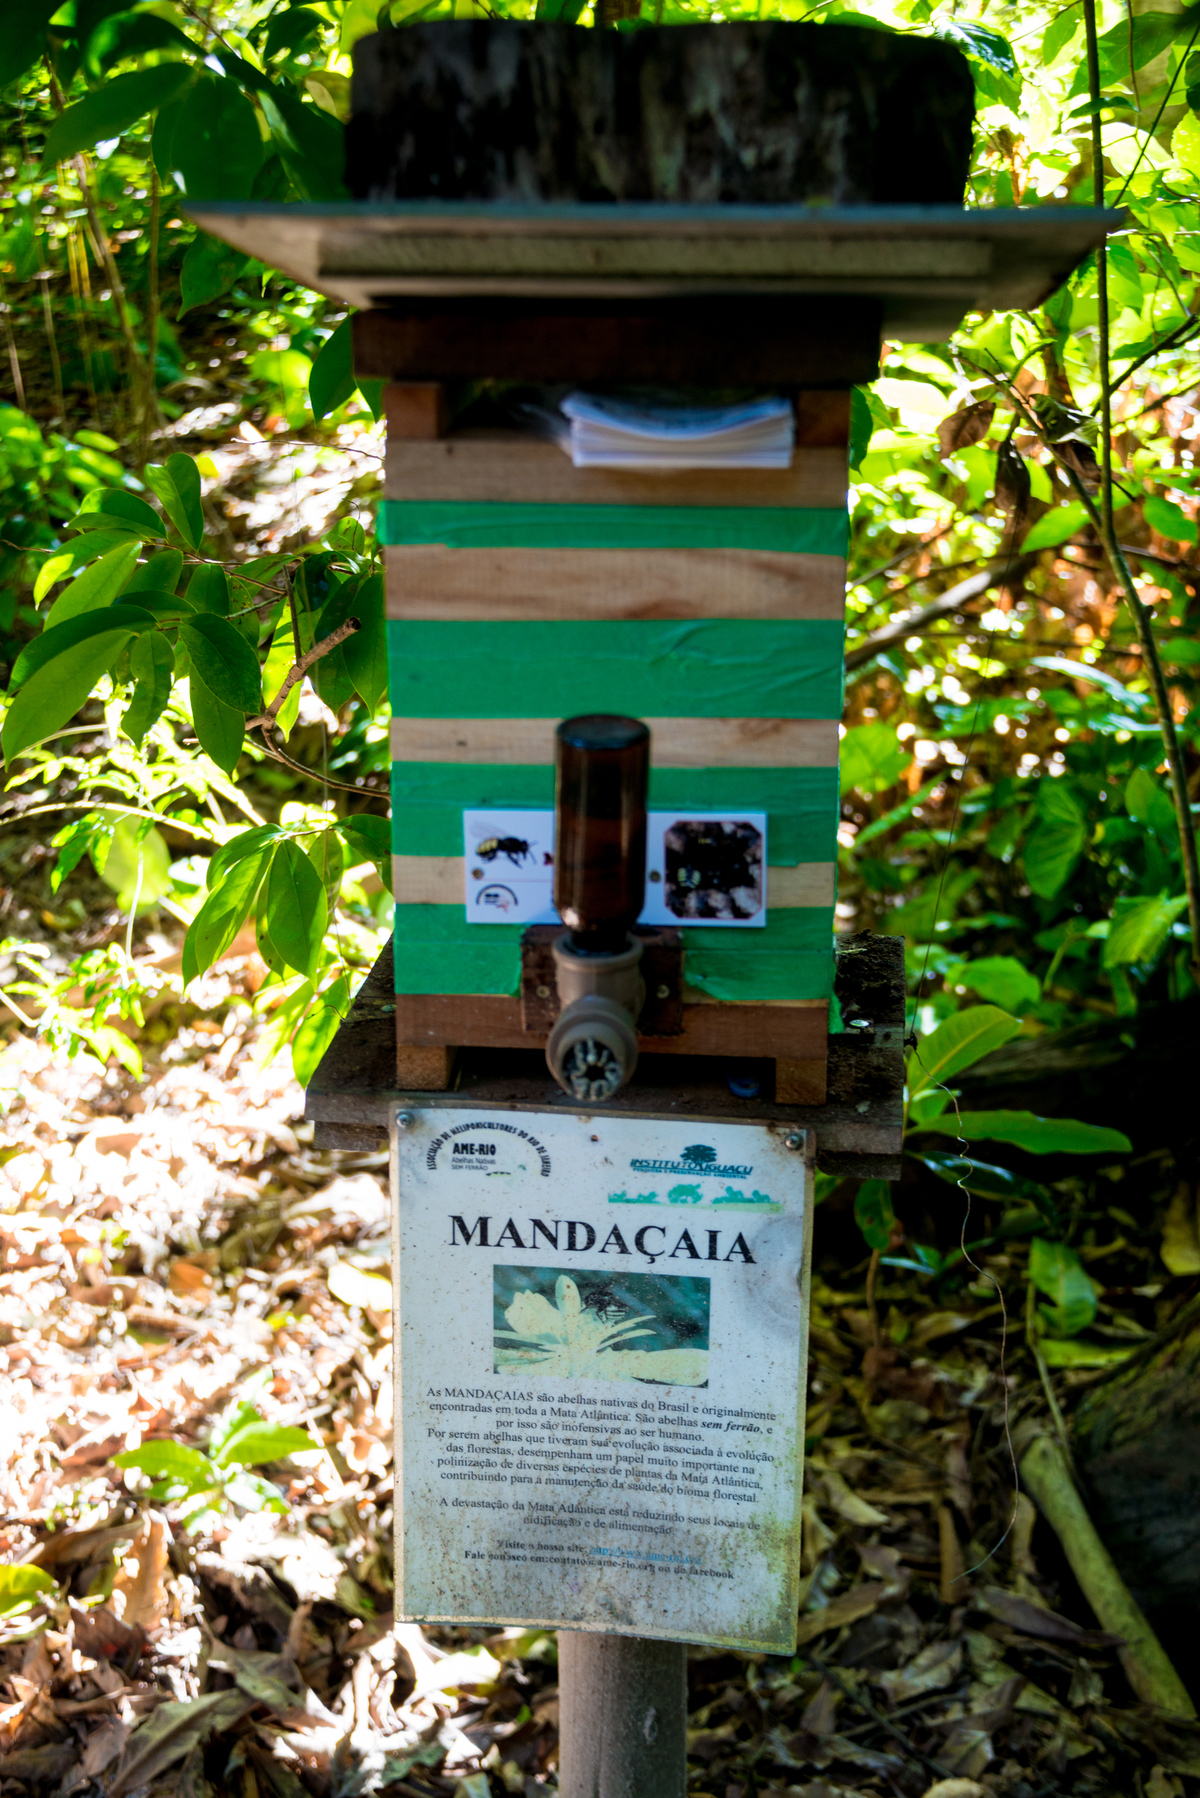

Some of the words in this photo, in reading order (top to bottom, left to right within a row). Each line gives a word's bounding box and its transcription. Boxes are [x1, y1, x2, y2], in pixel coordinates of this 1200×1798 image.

[440, 1132, 451, 1141] DE
[518, 1130, 528, 1138] DO
[527, 1137, 540, 1146] RIO
[453, 1143, 496, 1155] AME-RIO
[536, 1146, 548, 1154] DE
[539, 1155, 551, 1177] JANEIRO
[630, 1159, 697, 1169] INSTITUTO
[705, 1164, 753, 1174] IGUAÇU
[448, 1215, 757, 1265] MANDAÇAIA
[427, 1387, 441, 1397] As
[445, 1388, 533, 1401] MANDAÇAIAS
[537, 1393, 554, 1403] são
[558, 1395, 597, 1405] abelhas
[601, 1399, 638, 1408] nativas
[641, 1400, 655, 1410] do
[659, 1401, 689, 1413] Brasil
[702, 1406, 776, 1421] originalmente
[430, 1402, 492, 1413] encontradas
[515, 1406, 538, 1415] toda
[550, 1407, 577, 1418] Mata
[581, 1408, 631, 1421] Atlântica.
[635, 1413, 655, 1423] São
[659, 1416, 698, 1427] abelhas
[724, 1421, 763, 1435] ferrão,
[496, 1420, 514, 1429] por
[517, 1419, 537, 1429] isso
[541, 1420, 558, 1430] são
[562, 1420, 621, 1435] inofensivas
[659, 1429, 704, 1442] humano.
[427, 1428, 446, 1438] Por
[449, 1431, 479, 1439] serem
[483, 1431, 522, 1442] abelhas
[526, 1436, 545, 1444] que
[548, 1435, 587, 1446] tiveram
[613, 1440, 659, 1451] evolução
[663, 1444, 713, 1456] associada
[717, 1446, 723, 1456] à
[727, 1450, 774, 1463] evolução
[446, 1443, 463, 1453] das
[468, 1444, 514, 1456] florestas,
[518, 1447, 593, 1460] desempenham
[596, 1453, 612, 1461] um
[616, 1454, 644, 1464] papel
[648, 1456, 678, 1467] muito
[682, 1459, 739, 1472] importante
[742, 1466, 754, 1474] na
[437, 1457, 498, 1468] polinização
[500, 1459, 513, 1469] de
[517, 1460, 559, 1471] diversas
[563, 1463, 606, 1475] espécies
[609, 1466, 622, 1475] de
[625, 1467, 662, 1479] plantas
[665, 1471, 678, 1480] da
[681, 1472, 708, 1484] Mata
[712, 1475, 763, 1490] Atlântica,
[441, 1471, 507, 1482] contribuindo
[510, 1475, 533, 1484] para
[545, 1477, 608, 1488] manutenção
[612, 1479, 624, 1489] da
[628, 1481, 657, 1492] saúde
[661, 1484, 673, 1494] do
[677, 1486, 709, 1497] bioma
[713, 1488, 759, 1503] florestal.
[439, 1498, 448, 1507] A
[452, 1498, 509, 1510] devastação
[512, 1501, 525, 1510] da
[528, 1502, 555, 1512] Mata
[558, 1503, 605, 1515] Atlântica
[609, 1507, 629, 1516] está
[632, 1510, 685, 1522] reduzindo
[688, 1517, 710, 1525] seus
[714, 1517, 744, 1529] locais
[748, 1520, 760, 1530] de
[523, 1516, 581, 1528] nidificação
[594, 1520, 605, 1528] de
[609, 1521, 675, 1535] alimentação.
[465, 1551, 486, 1560] Fale
[488, 1552, 527, 1562] conosco
[497, 1540, 525, 1549] Visite
[537, 1542, 564, 1551] nosso
